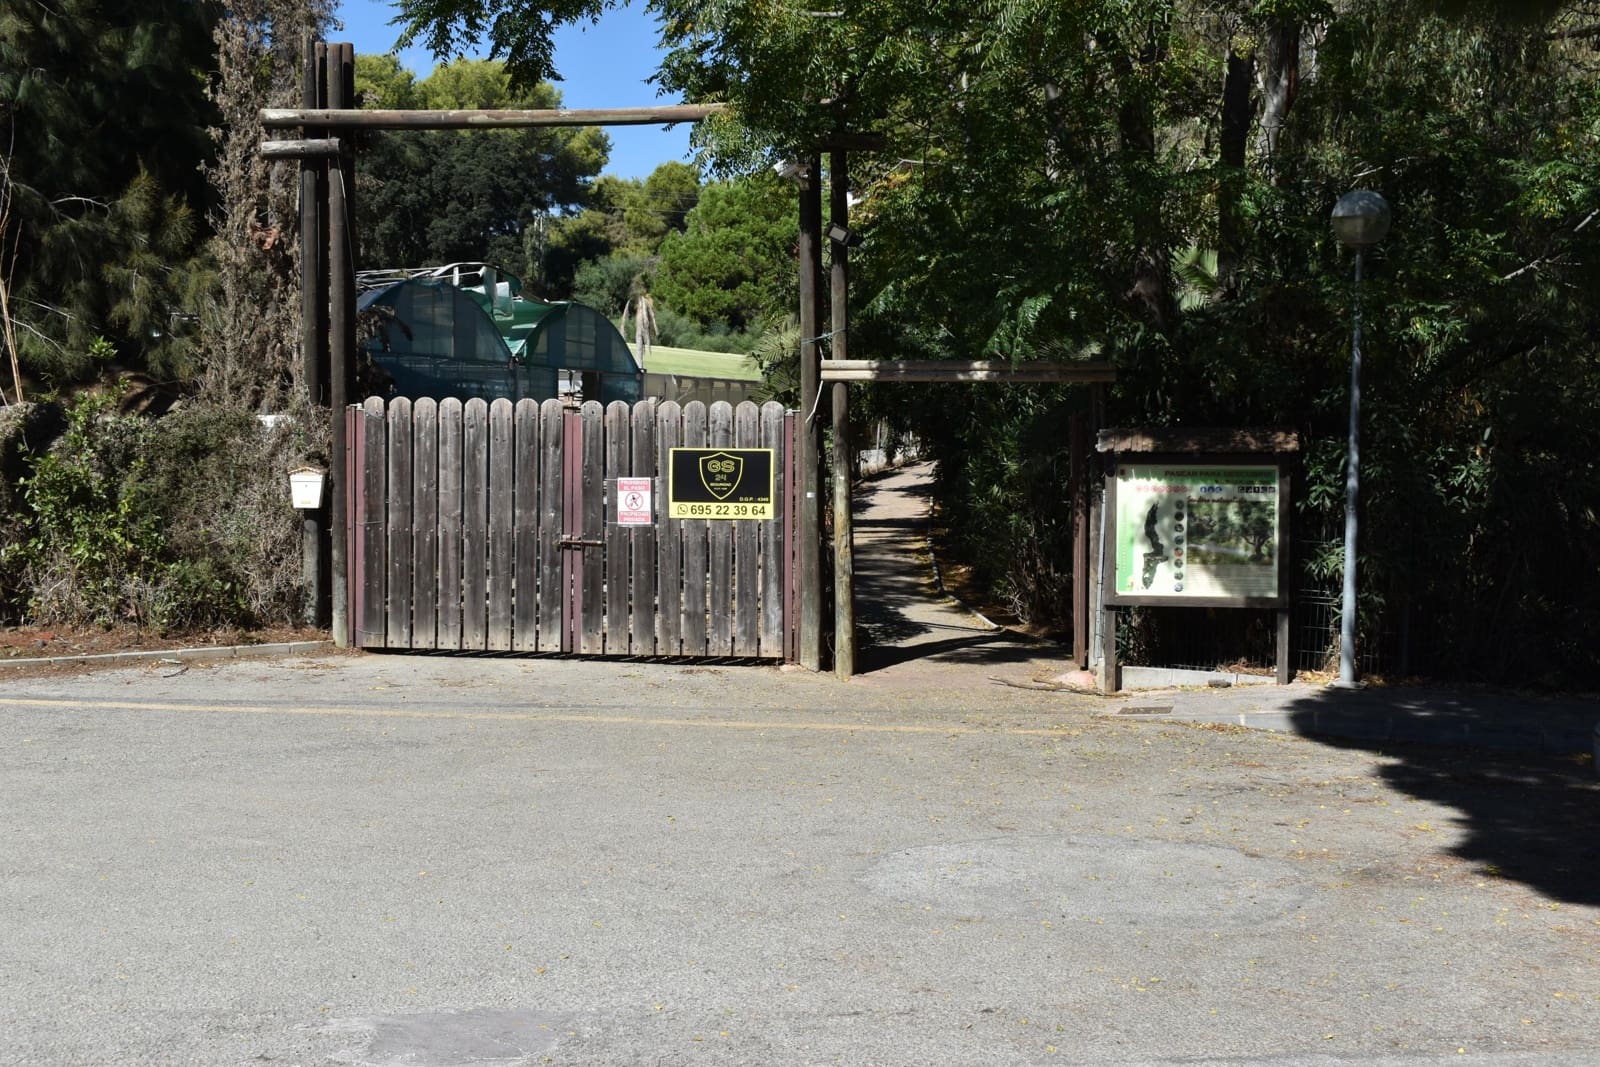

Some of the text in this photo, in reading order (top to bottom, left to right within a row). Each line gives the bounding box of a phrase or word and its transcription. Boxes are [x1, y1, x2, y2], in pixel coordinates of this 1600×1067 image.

[707, 460, 735, 473] GS
[690, 505, 766, 516] 695 22 39 64
